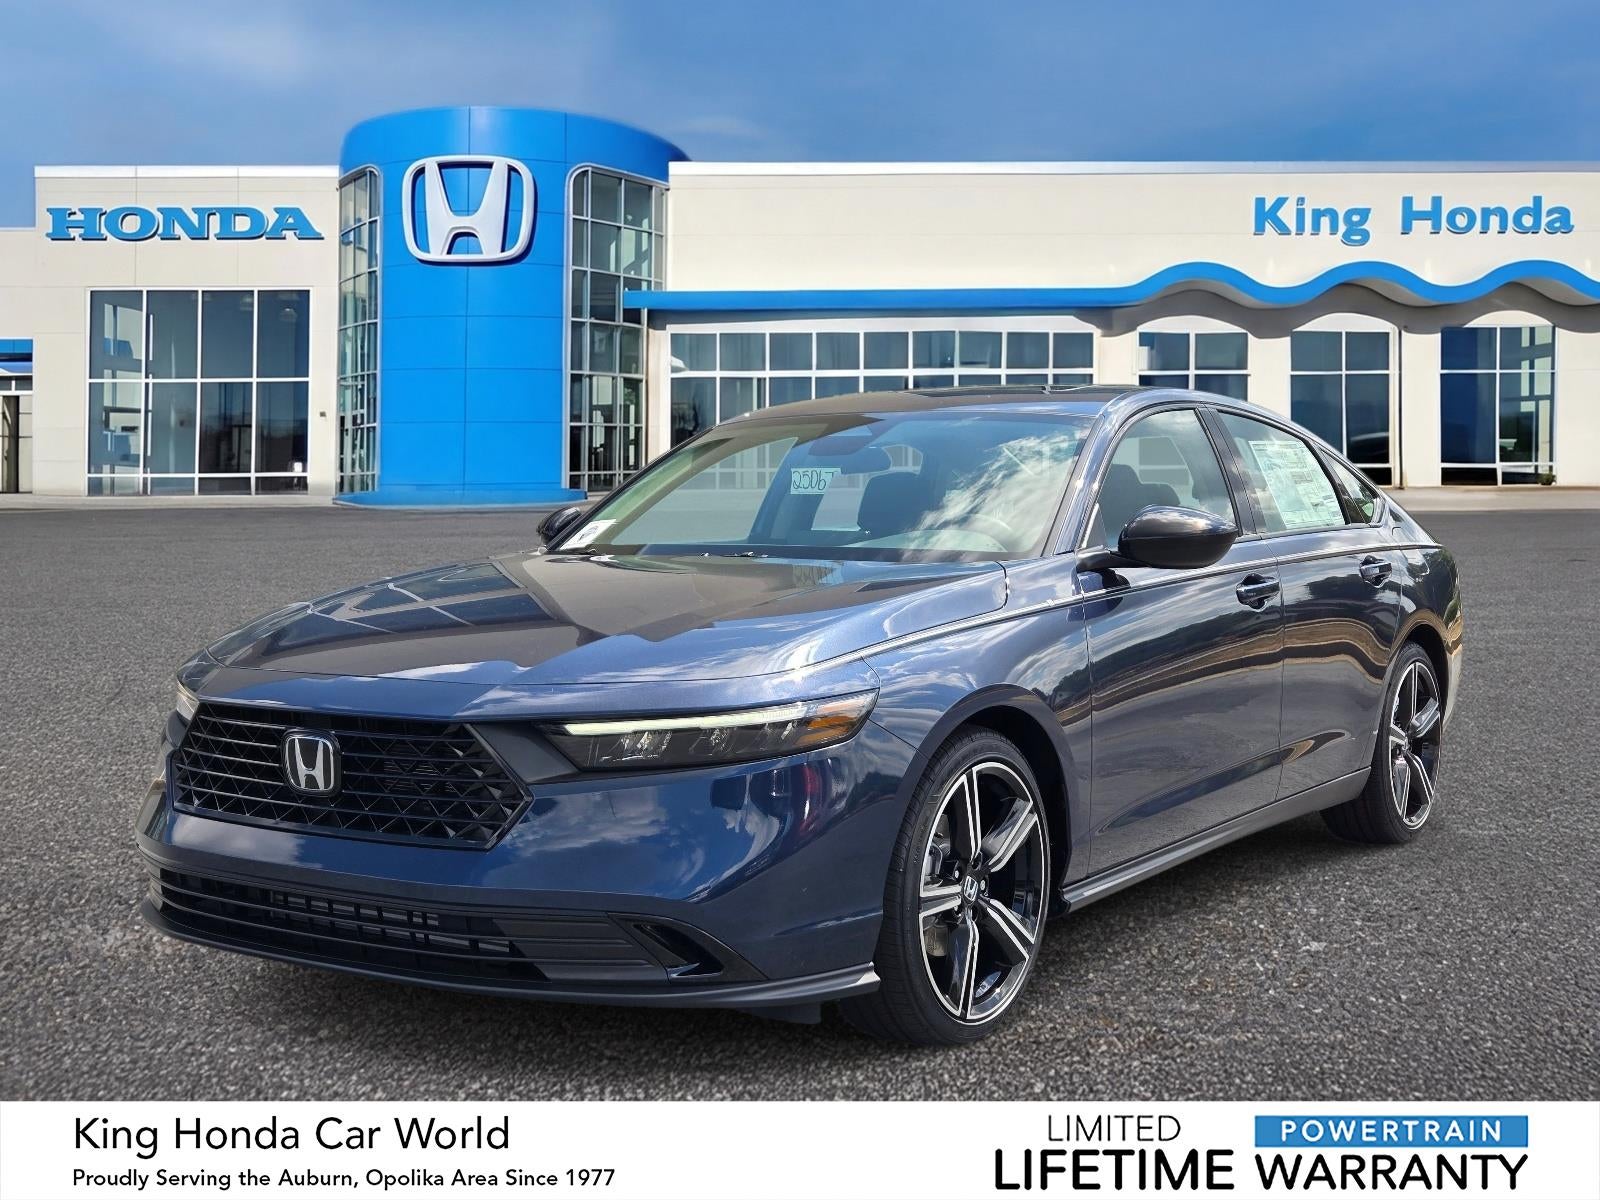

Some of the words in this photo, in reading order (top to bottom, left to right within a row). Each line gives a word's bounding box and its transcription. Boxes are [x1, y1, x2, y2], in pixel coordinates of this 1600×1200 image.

[46, 206, 323, 241] HONDA
[1254, 195, 1371, 246] King
[1401, 195, 1574, 235] Honda
